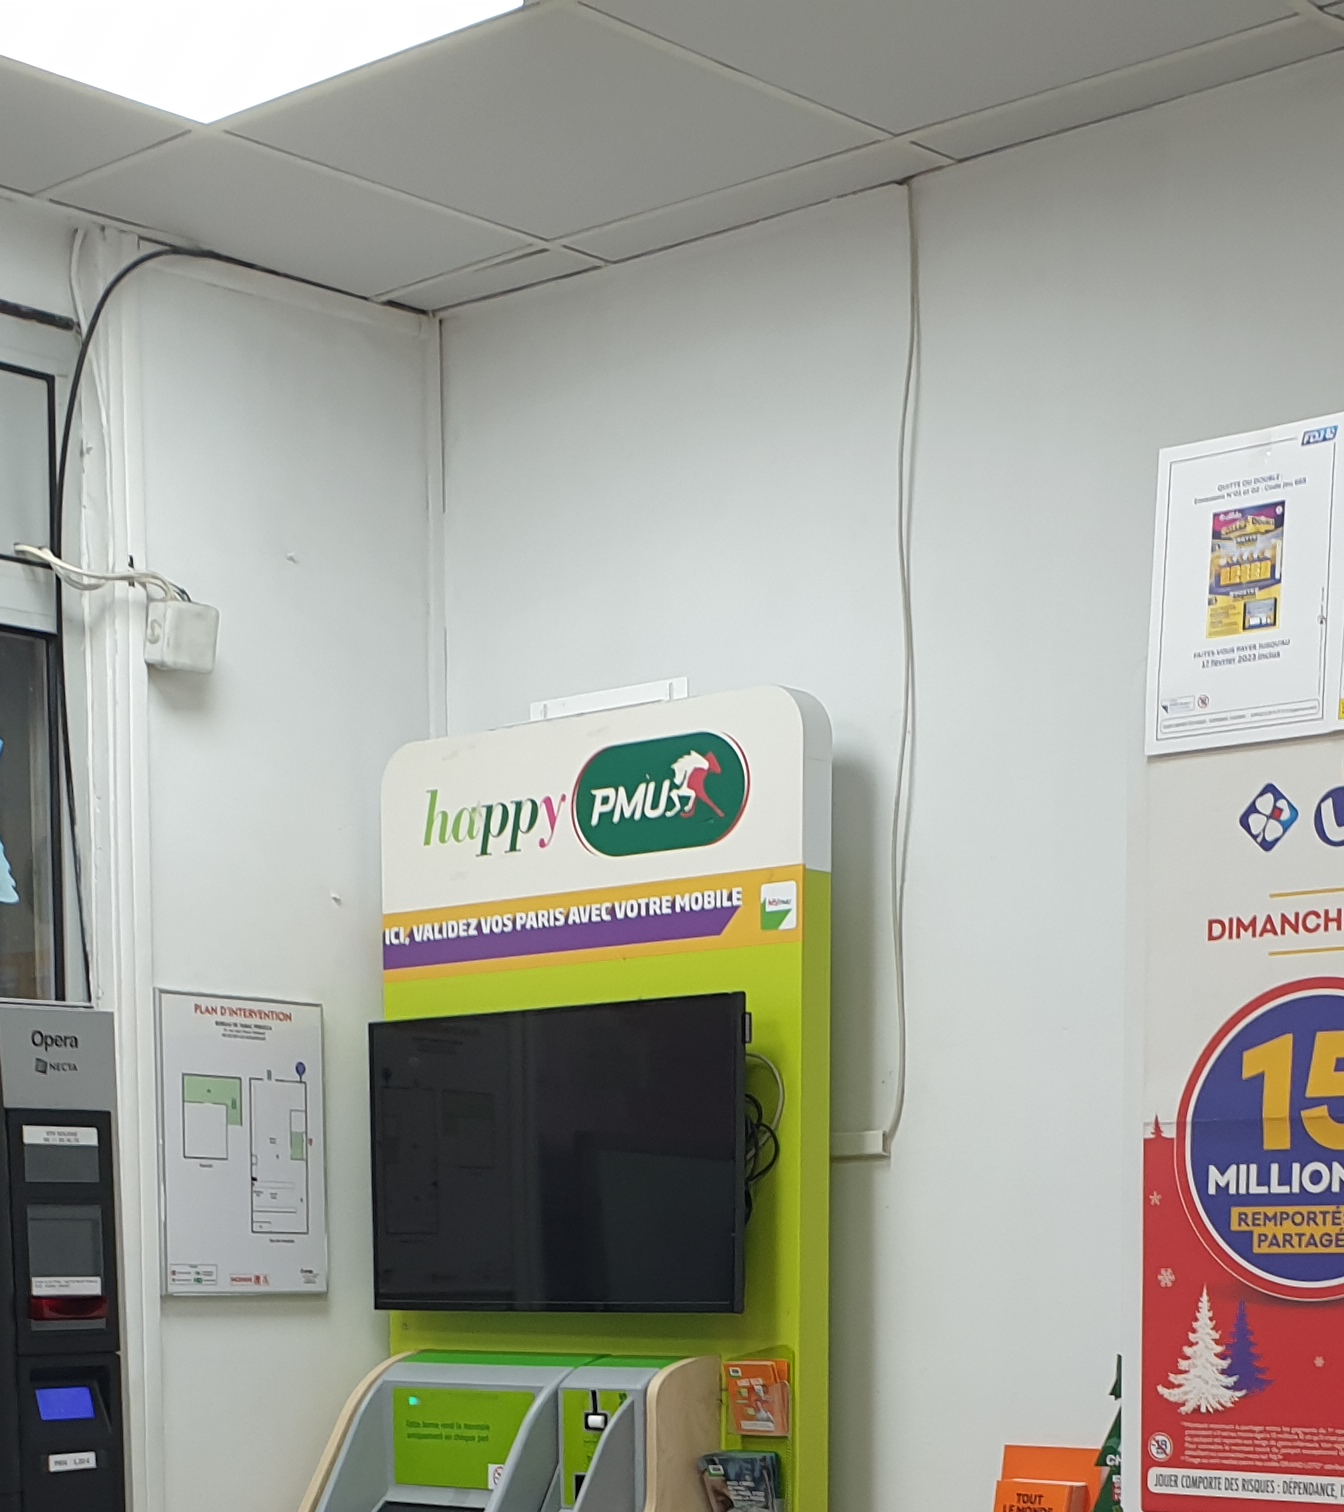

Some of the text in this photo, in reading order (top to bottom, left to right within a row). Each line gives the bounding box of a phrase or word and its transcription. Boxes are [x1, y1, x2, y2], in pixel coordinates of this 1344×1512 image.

[590, 774, 673, 828] PMU
[423, 788, 567, 857] happy
[384, 887, 744, 946] ICI, VALIDEZ VOS PARIS AVEC VOTRE MOBILE
[194, 1003, 293, 1022] PLAN D'INTERVENTION
[31, 1030, 79, 1051] Opera
[49, 1062, 78, 1073] NECTA
[1155, 1472, 1179, 1490] JOUER
[1181, 1474, 1222, 1493] COMPORTE
[1224, 1477, 1240, 1494] DES
[1242, 1477, 1275, 1495] RISQUES
[1282, 1479, 1337, 1500] DÉPENDANCE,
[1016, 1493, 1044, 1505] TOUT
